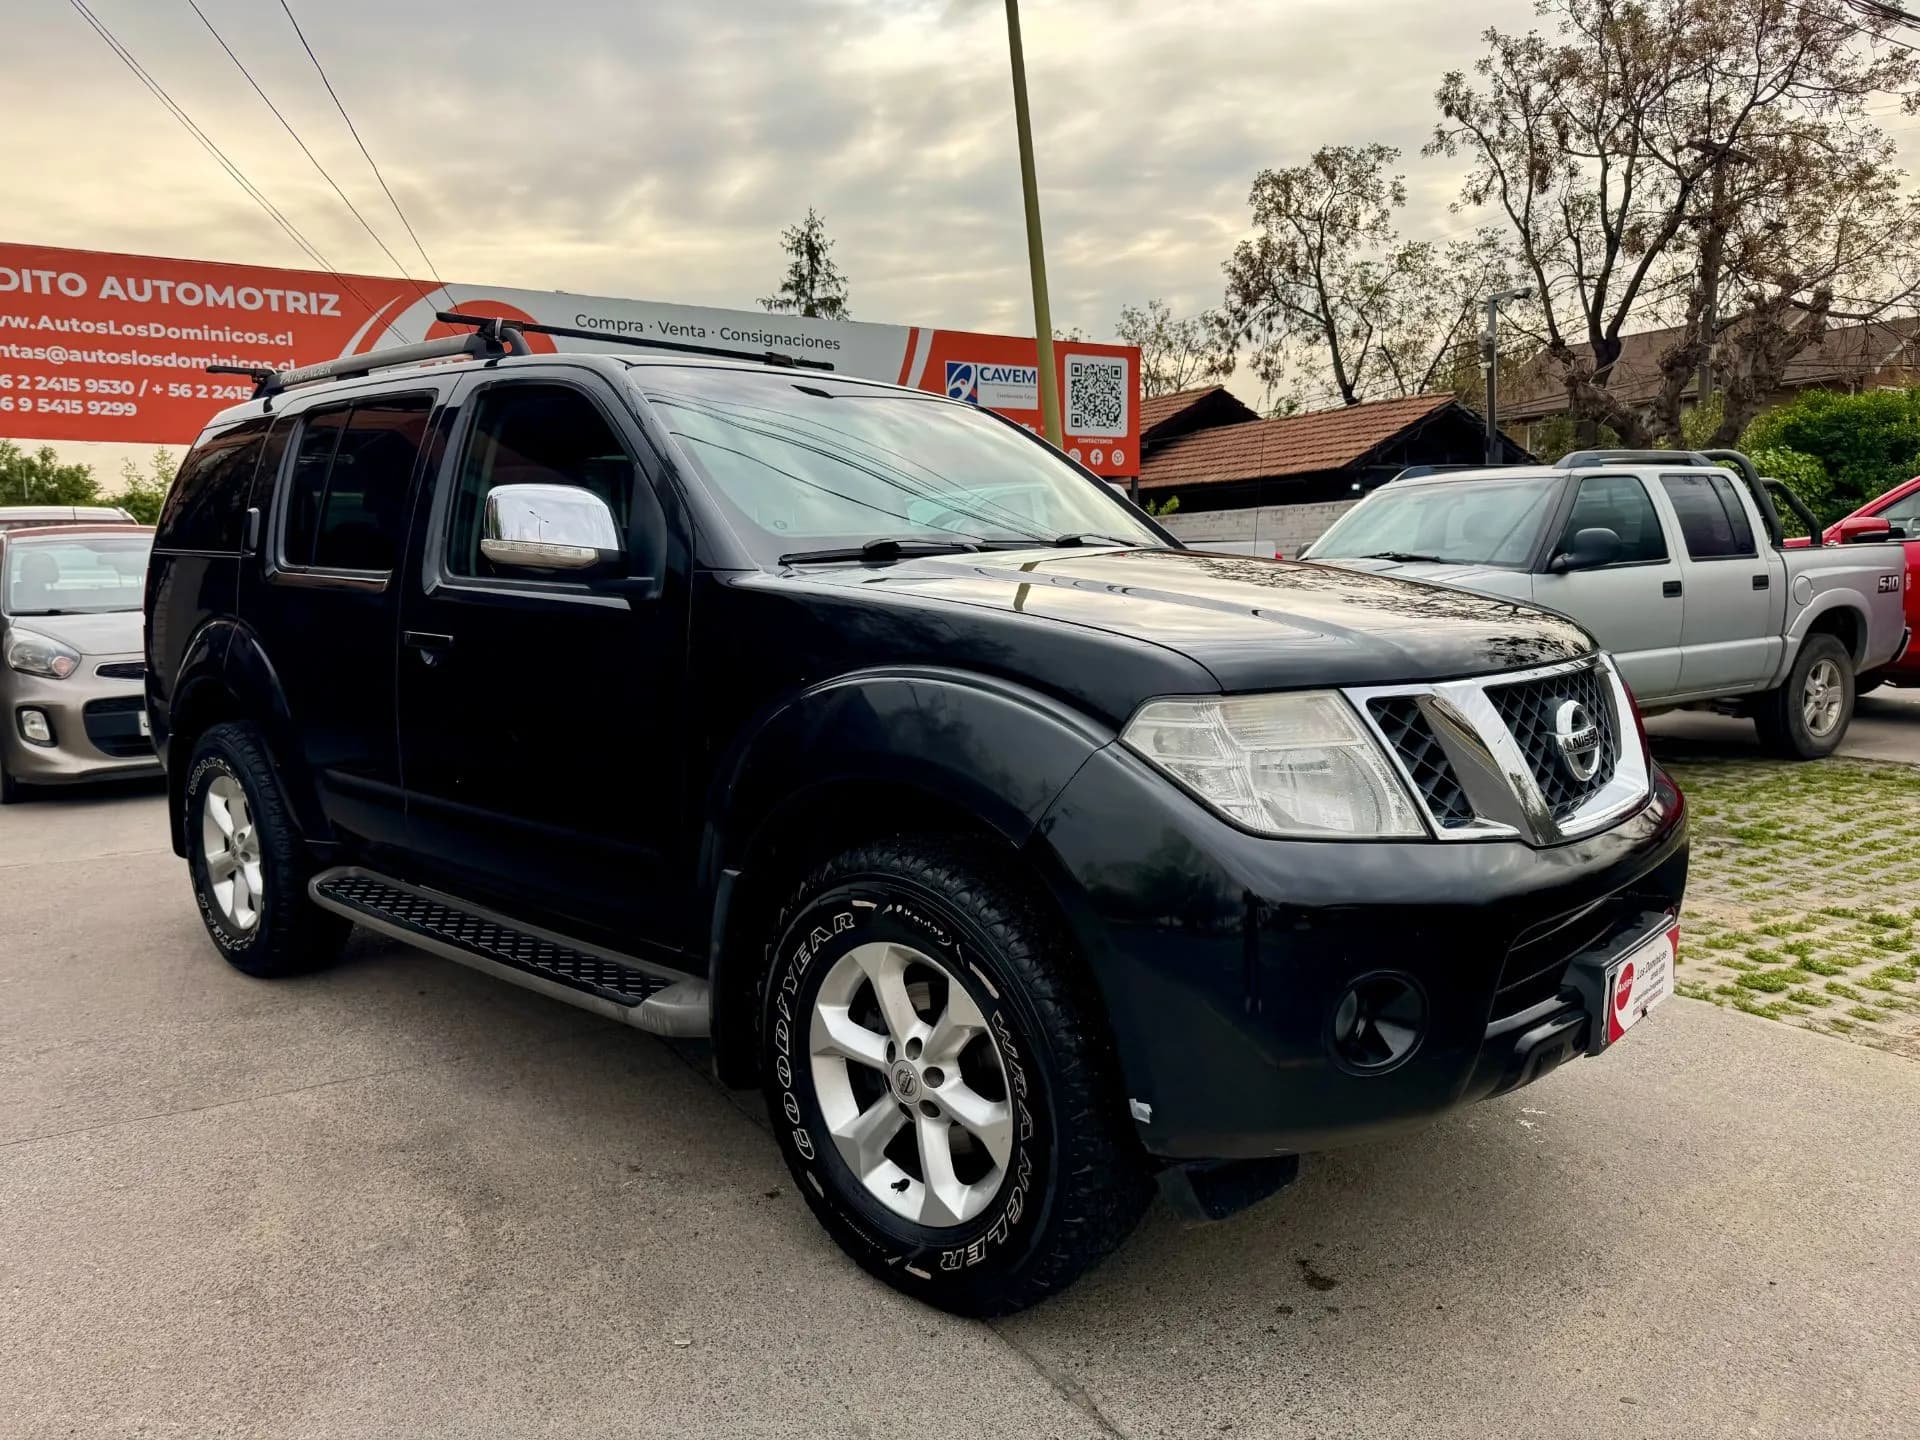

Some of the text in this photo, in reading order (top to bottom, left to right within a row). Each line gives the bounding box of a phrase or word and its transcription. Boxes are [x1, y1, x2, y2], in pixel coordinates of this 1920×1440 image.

[98, 276, 341, 317] AUTOMOTRIZ
[575, 313, 841, 351] Compra Venta Consignaciones
[0, 374, 14, 389] 6
[17, 375, 31, 390] 2
[35, 376, 81, 393] 2415
[85, 378, 134, 395] 9530
[152, 385, 163, 395] +
[168, 383, 193, 398] 56
[196, 385, 209, 399] 2
[212, 385, 253, 401] 2415
[979, 366, 1037, 385] CAVEM
[0, 396, 137, 417] 6 9 5415 9299
[775, 911, 856, 1161] GOODYEAR
[939, 1009, 1034, 1271] WRANGLER
